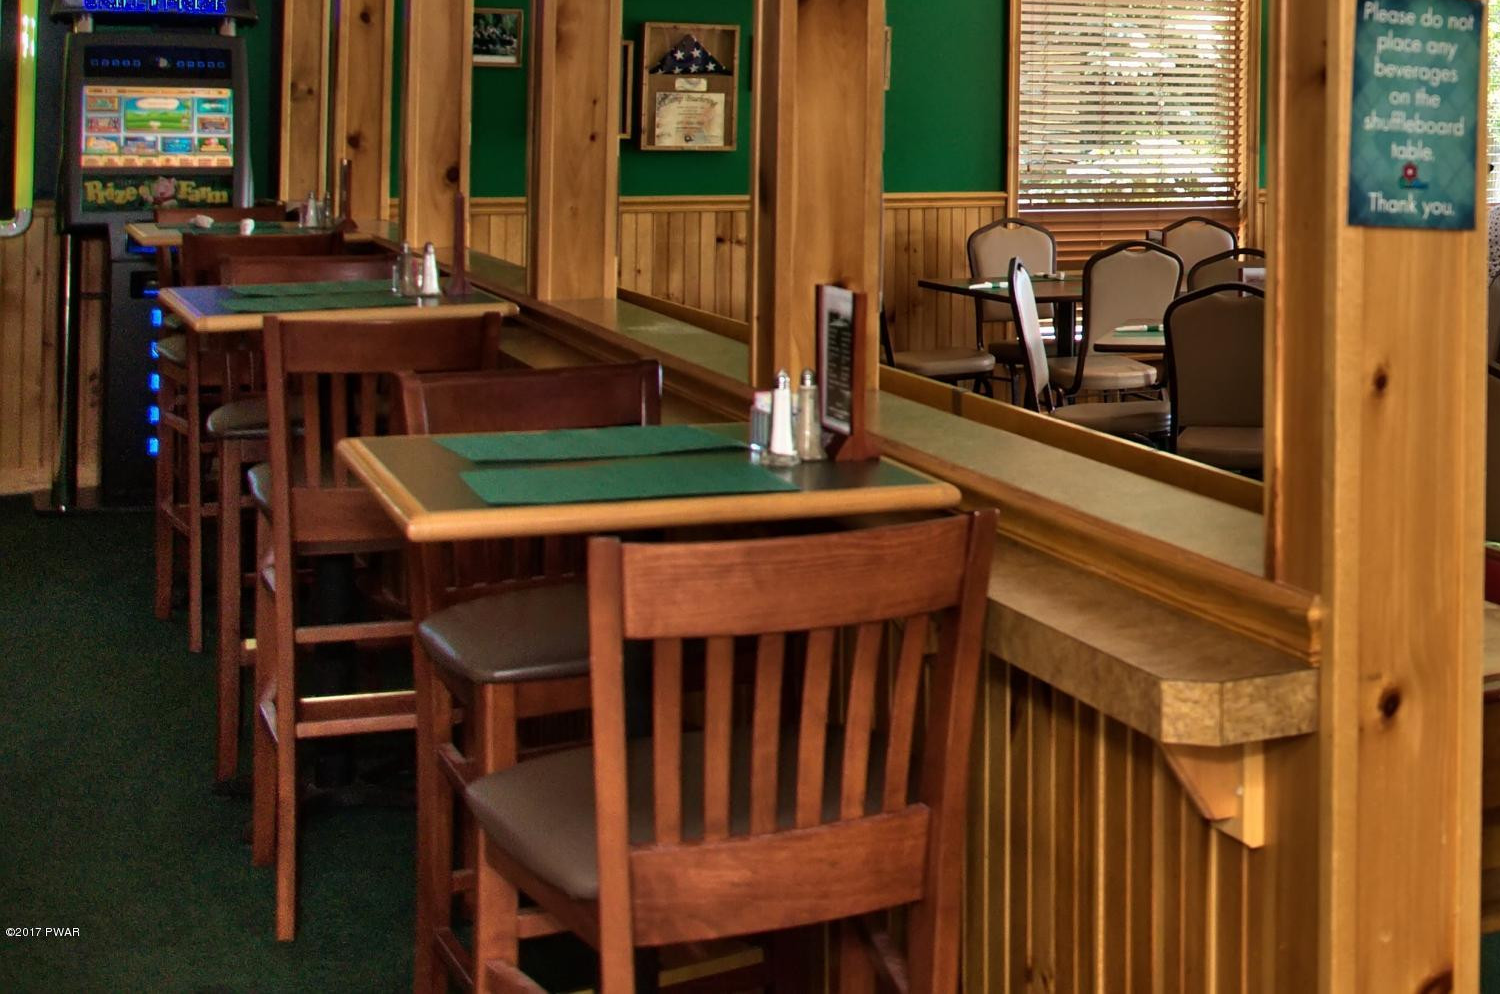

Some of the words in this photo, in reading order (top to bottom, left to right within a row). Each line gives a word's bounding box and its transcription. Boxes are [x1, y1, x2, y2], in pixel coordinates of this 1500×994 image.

[1363, 1, 1417, 24] Please
[1420, 7, 1443, 29] do
[1448, 14, 1475, 32] not
[1376, 29, 1423, 54] place
[1426, 39, 1459, 62] any
[1373, 55, 1459, 87] beverages
[1388, 90, 1411, 106] on
[1415, 86, 1441, 107] the
[1363, 108, 1466, 137] shuffleboard
[175, 180, 229, 204] Farm
[1368, 191, 1418, 214] Thank
[1422, 199, 1456, 220] you.
